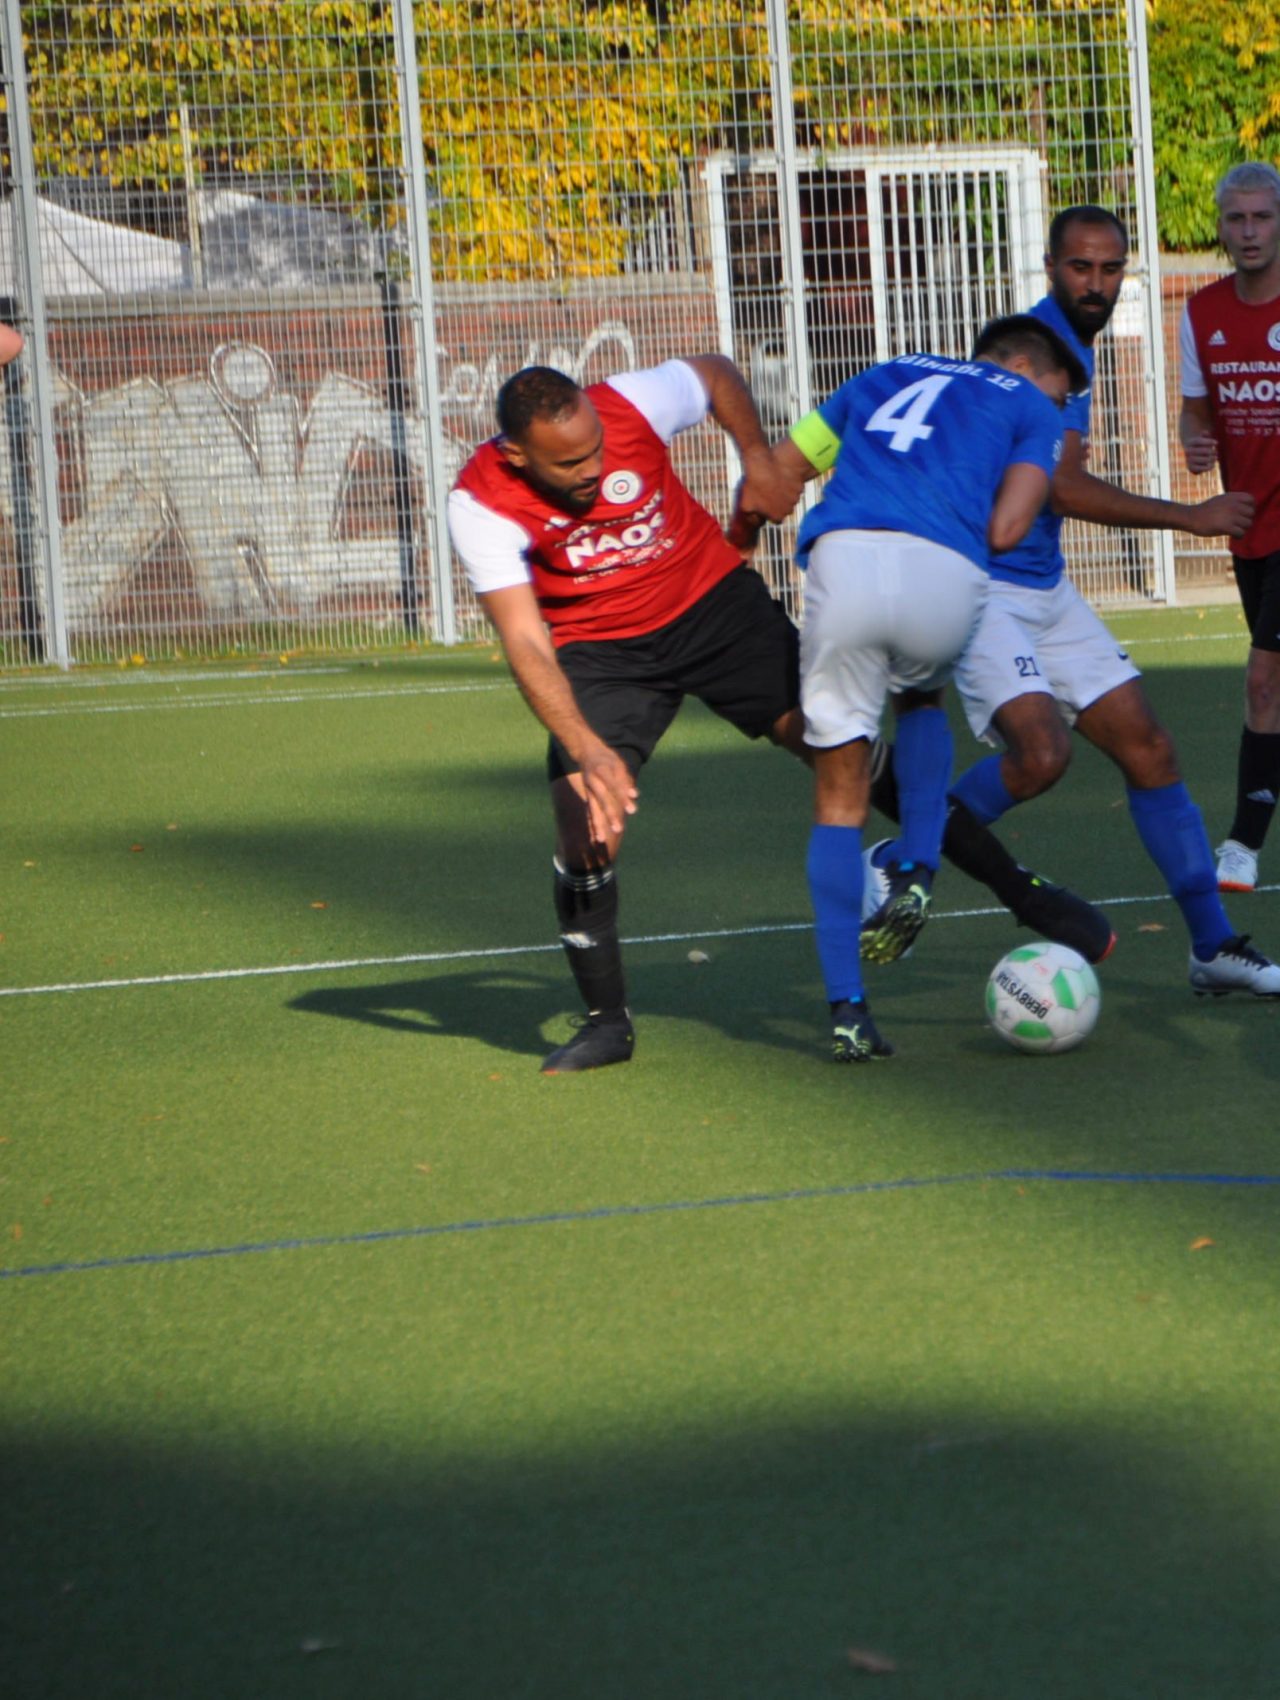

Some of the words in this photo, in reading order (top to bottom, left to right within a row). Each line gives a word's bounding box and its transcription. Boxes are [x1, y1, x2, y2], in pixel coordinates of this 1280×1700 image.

[985, 372, 1022, 392] 12
[864, 373, 955, 453] 4
[1014, 656, 1041, 678] 21
